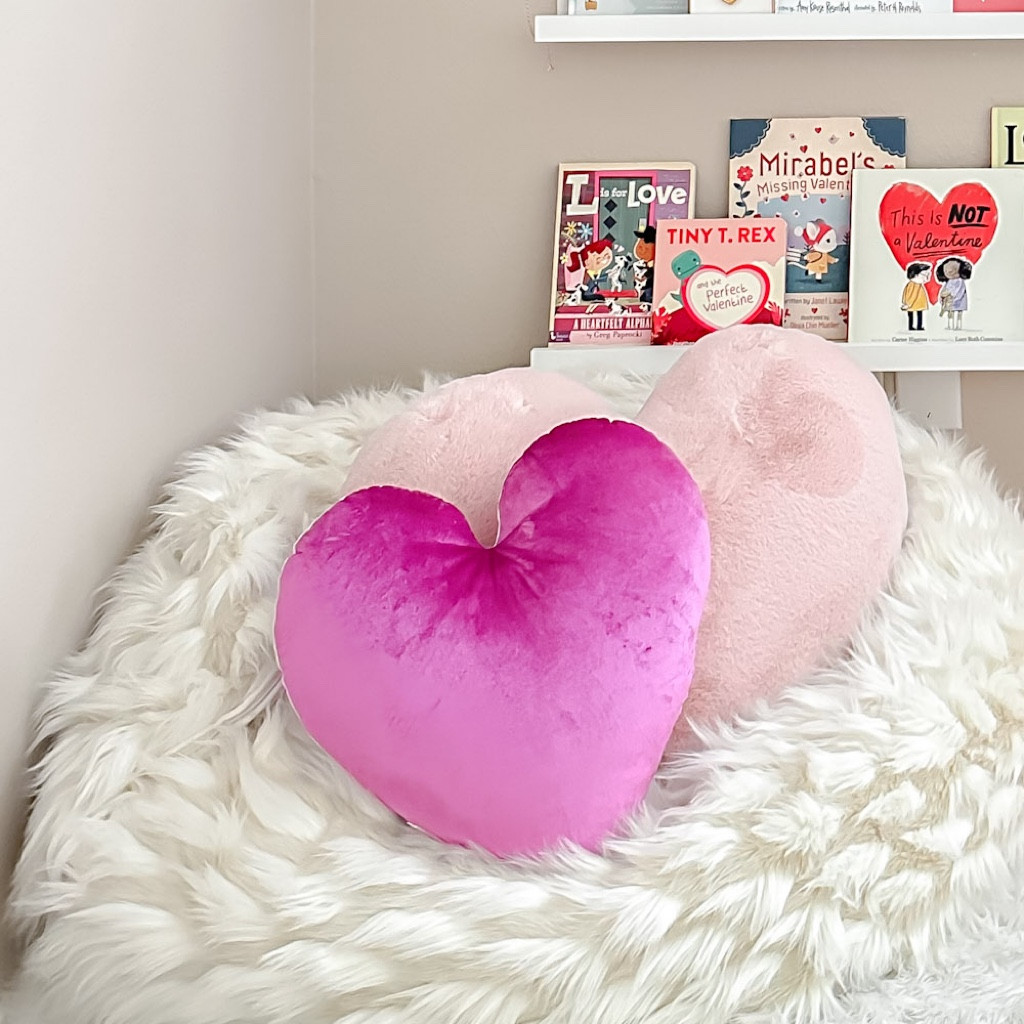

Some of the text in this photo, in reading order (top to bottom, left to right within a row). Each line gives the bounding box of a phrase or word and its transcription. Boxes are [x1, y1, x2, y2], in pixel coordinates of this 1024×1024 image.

[760, 152, 875, 176] Mirabel's
[566, 174, 687, 216] L is for Love
[757, 178, 807, 197] Missing
[891, 206, 924, 228] This
[947, 203, 991, 225] NOT
[667, 226, 776, 245] TINY T. REX
[894, 230, 982, 254] a Valentine
[572, 317, 579, 330] A
[581, 317, 624, 330] HEARTFELT
